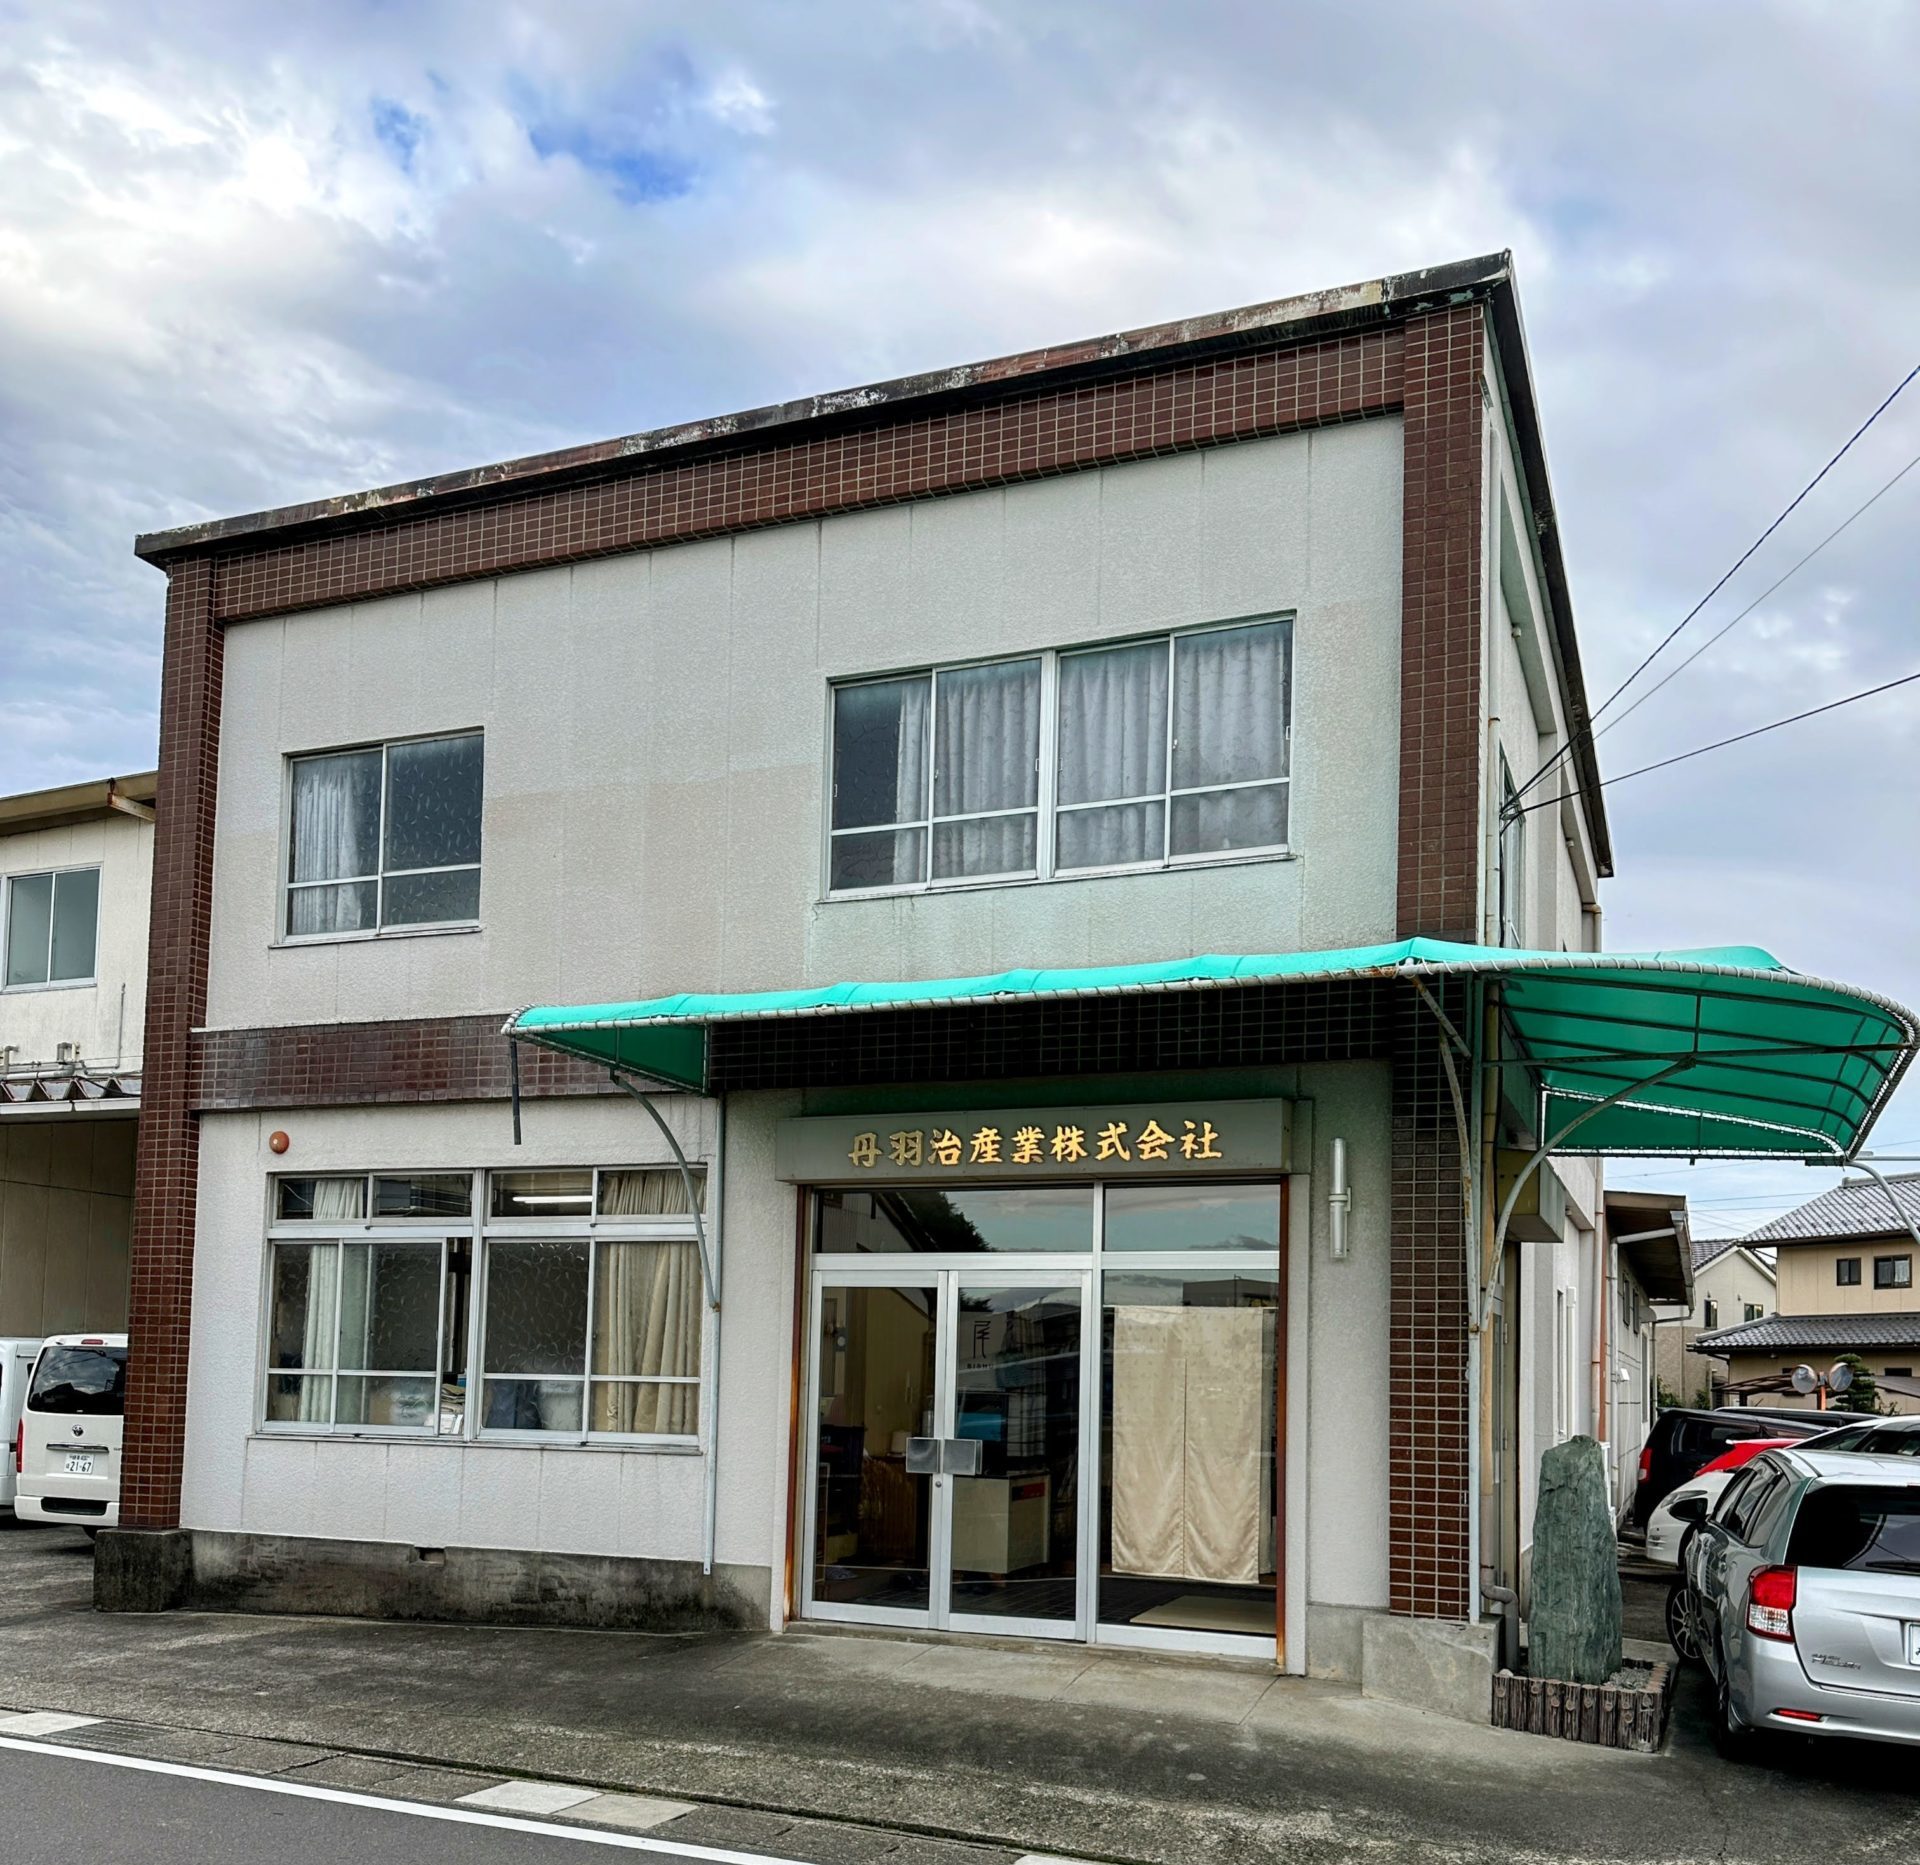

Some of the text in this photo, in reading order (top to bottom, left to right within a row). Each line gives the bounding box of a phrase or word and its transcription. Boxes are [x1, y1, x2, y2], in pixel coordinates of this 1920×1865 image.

[848, 1120, 1223, 1168] 丹羽治産業株式会社
